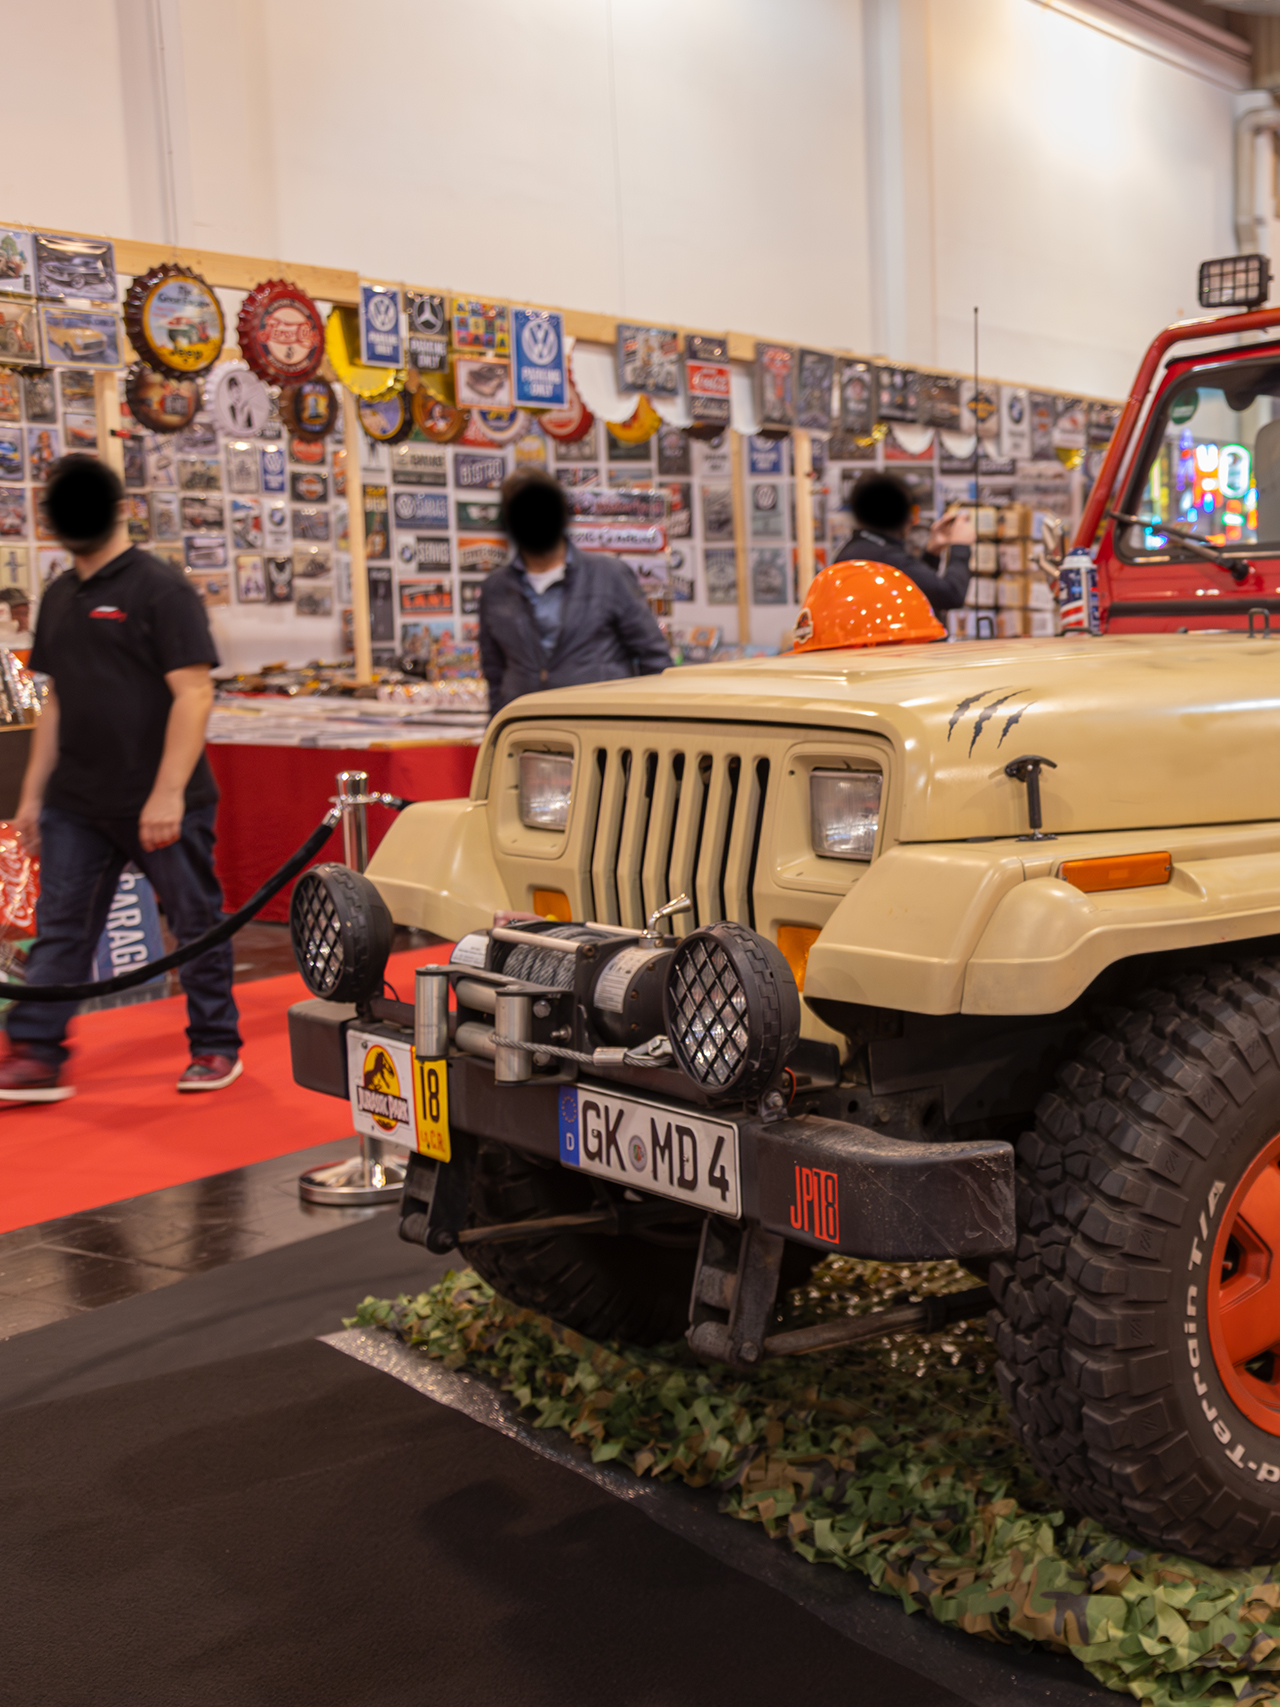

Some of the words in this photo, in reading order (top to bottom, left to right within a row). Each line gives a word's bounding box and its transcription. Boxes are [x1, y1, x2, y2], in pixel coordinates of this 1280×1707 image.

[367, 332, 398, 345] PARKING
[410, 338, 447, 355] PARKING
[374, 344, 394, 356] ONLY
[417, 354, 440, 369] ONLY
[521, 366, 562, 385] PARKING
[530, 382, 554, 398] ONLY
[420, 1065, 440, 1124] 18
[359, 1088, 388, 1117] JURASSIC
[387, 1095, 408, 1122] PARK
[566, 1132, 575, 1151] D
[582, 1099, 627, 1172] GK
[650, 1116, 698, 1192] MD
[708, 1135, 729, 1202] 4
[790, 1165, 840, 1244] JP18
[1188, 1180, 1227, 1272] T/A
